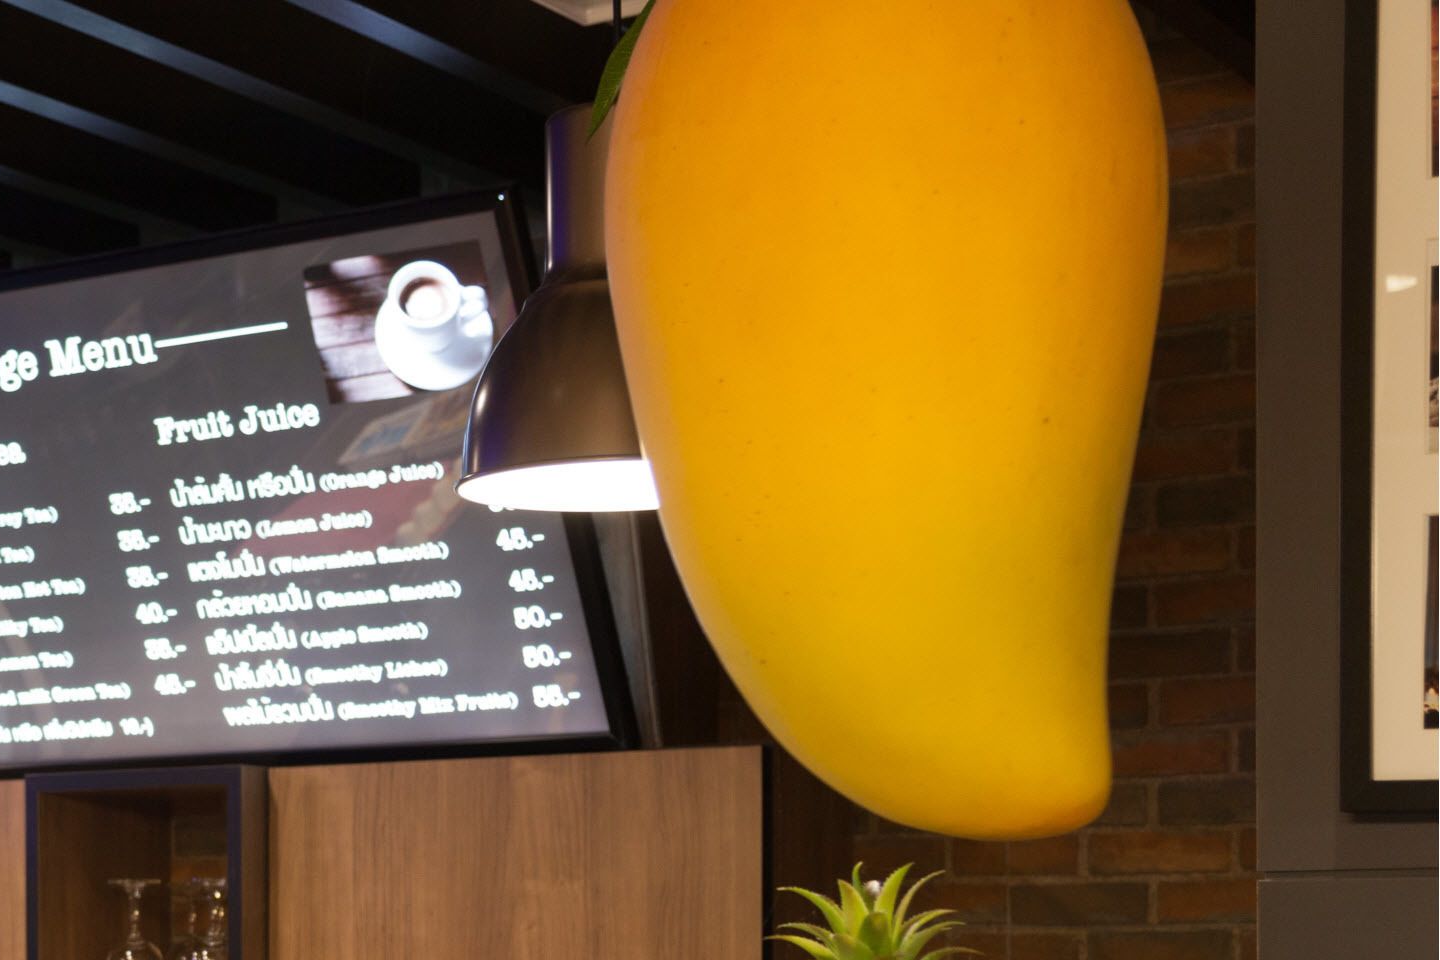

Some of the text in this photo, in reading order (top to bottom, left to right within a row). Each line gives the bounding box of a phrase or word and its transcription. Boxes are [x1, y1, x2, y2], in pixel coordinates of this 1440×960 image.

[44, 333, 157, 377] Menu
[153, 402, 320, 446] Fruit Juice
[389, 461, 444, 484] Juice)
[513, 605, 563, 630] 50.-
[522, 644, 572, 668] 50.-
